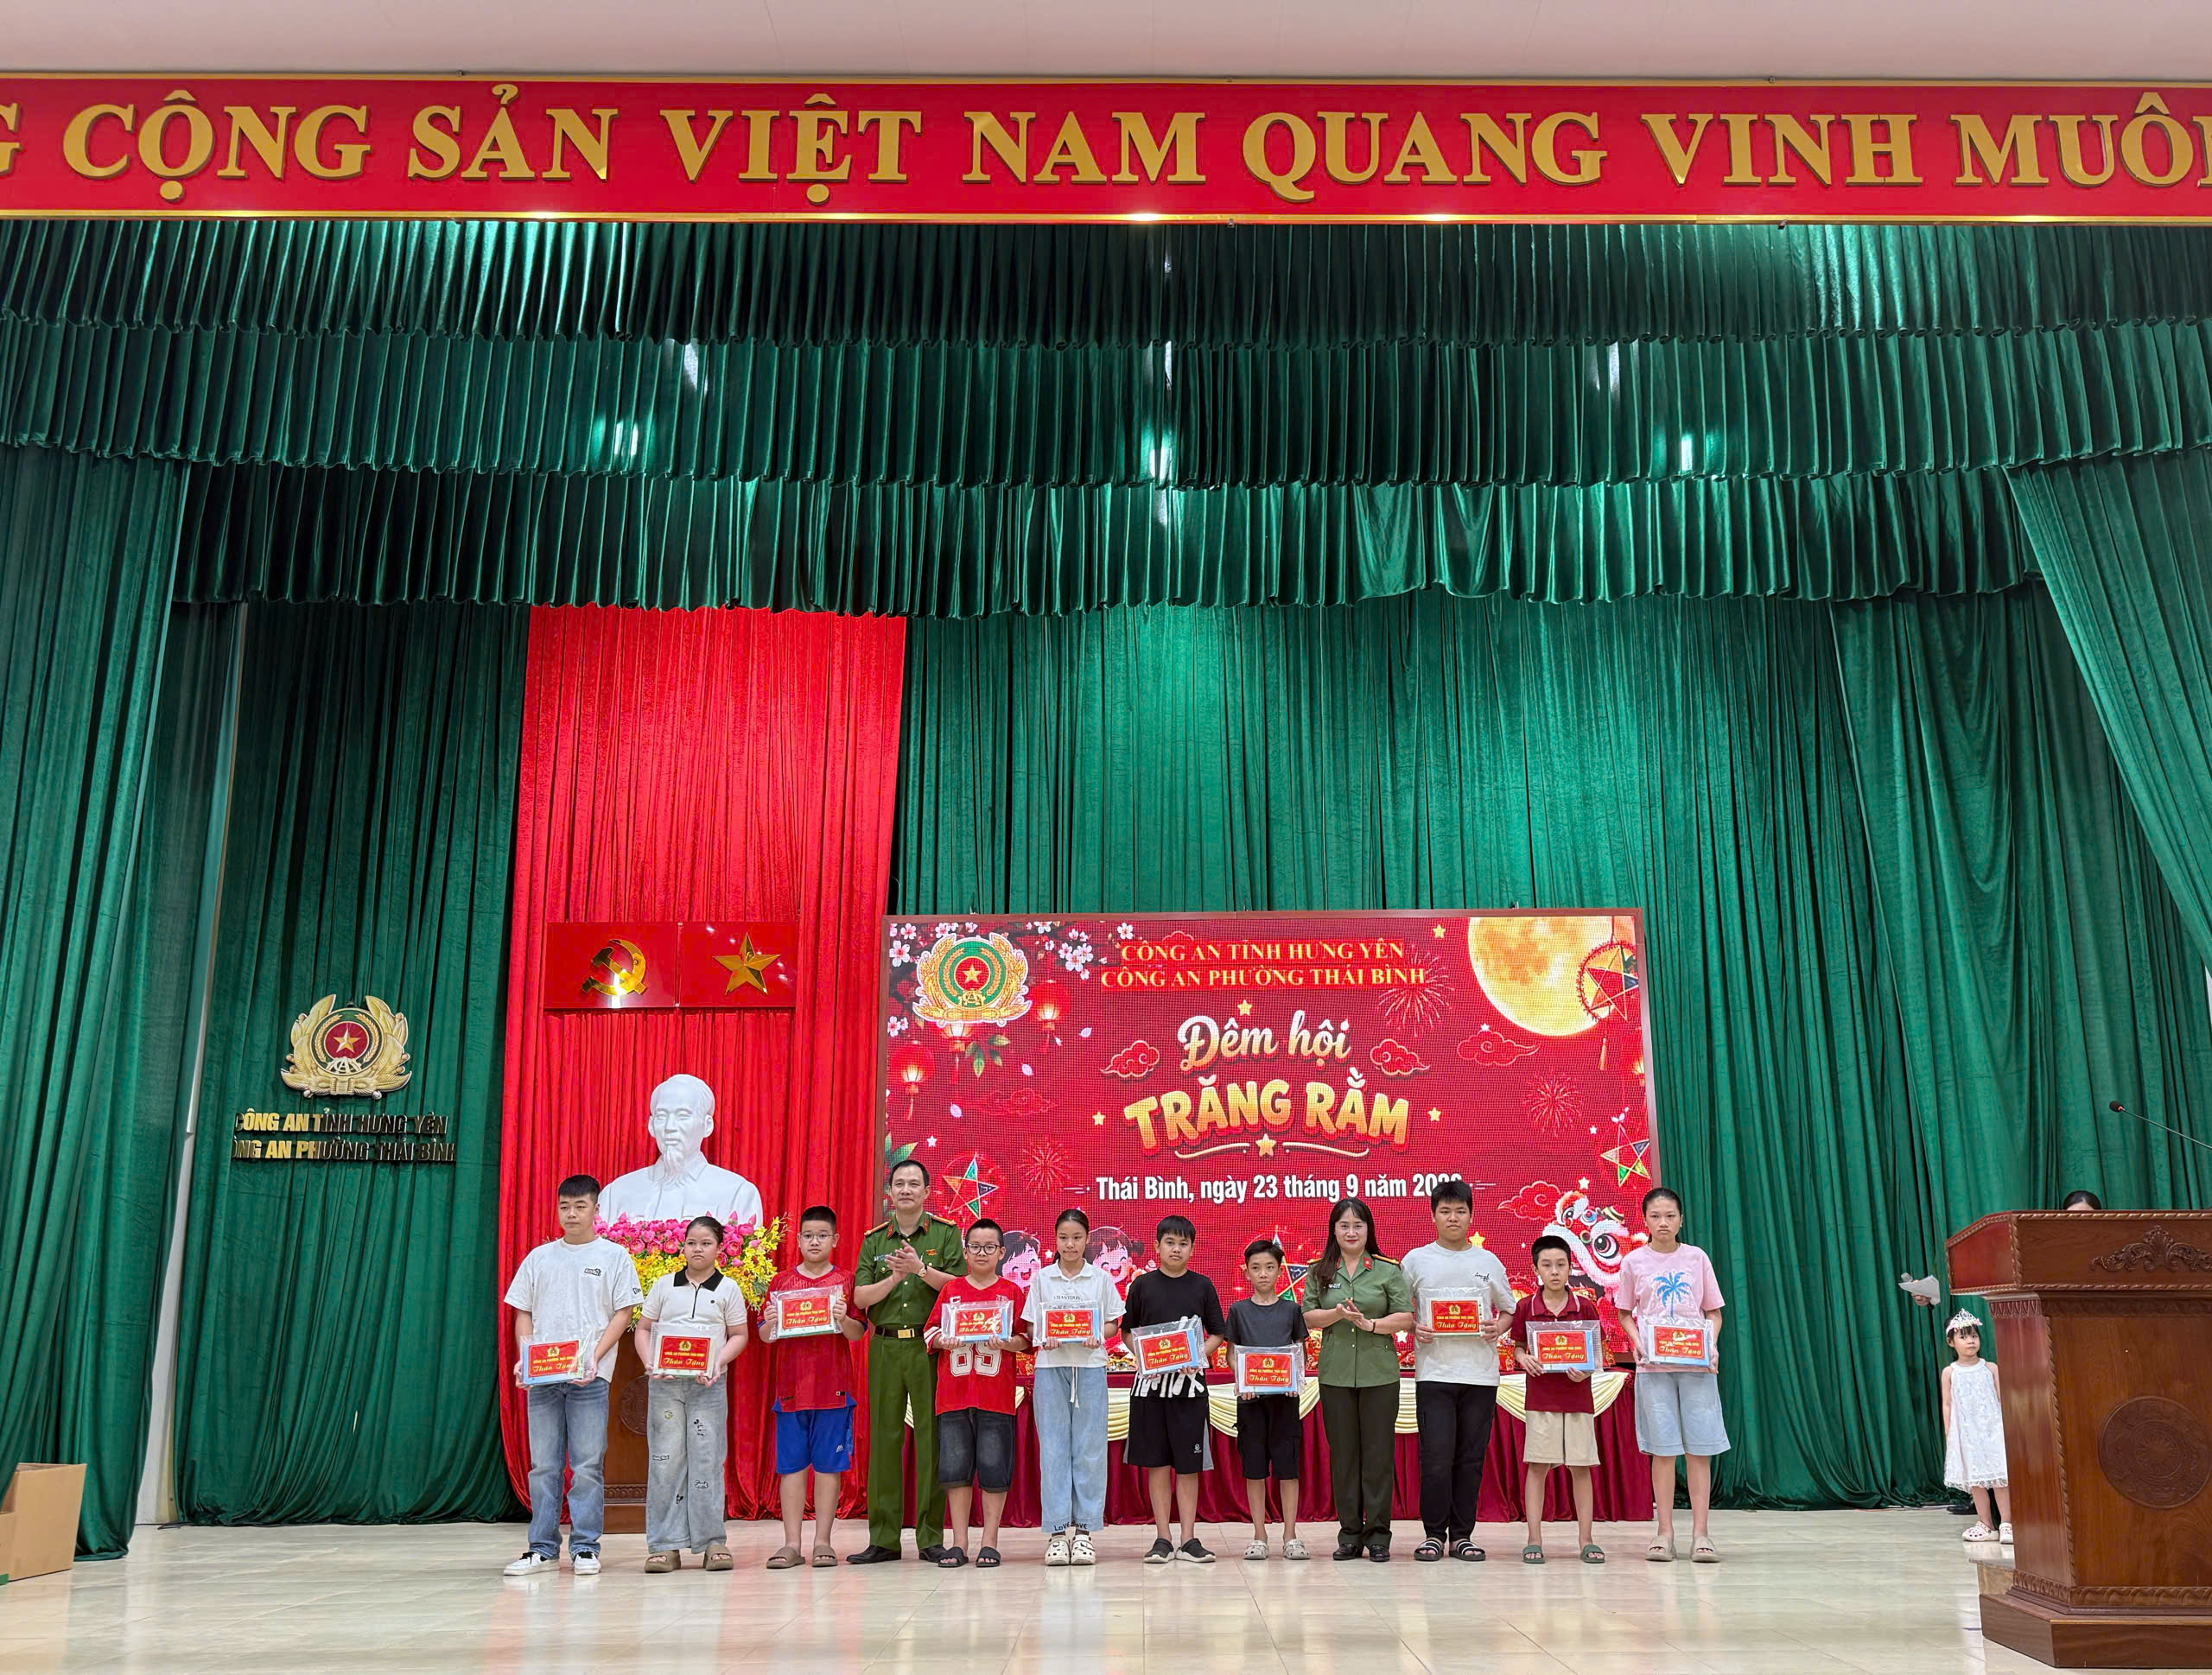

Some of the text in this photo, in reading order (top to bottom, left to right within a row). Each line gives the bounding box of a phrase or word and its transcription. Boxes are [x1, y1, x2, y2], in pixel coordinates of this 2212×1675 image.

[62, 90, 371, 200] CỘNG
[408, 84, 618, 181] SẢN
[660, 92, 921, 205] VIỆT
[963, 111, 1206, 185] NAM
[1243, 111, 1607, 203] QUANG
[1642, 113, 1923, 187] VINH
[1949, 92, 2212, 187] MUÔ
[1122, 940, 1185, 961] CÔNG
[1191, 944, 1220, 960] AN
[1288, 941, 1353, 960] HƯNG
[1359, 938, 1403, 959] YÊN
[1102, 963, 1425, 987] CÔNG AN PHƯỜNG THÁI BÌNH
[1177, 1009, 1352, 1071] Đêm hội
[234, 1107, 448, 1134] CÔNG AN TỈNH HƯNG YÊN
[1123, 1067, 1410, 1150] TRĂNG RẰM
[265, 1140, 292, 1158] AN
[296, 1136, 370, 1160] PHƯỜNG
[377, 1137, 415, 1161] THÁI
[1096, 1176, 1138, 1200] Thái
[1145, 1175, 1194, 1202] Bình,
[1200, 1175, 1248, 1204] ngày
[1253, 1174, 1278, 1198] 23
[1283, 1174, 1340, 1202] tháng
[1345, 1173, 1358, 1197] 9
[1364, 1174, 1407, 1197] năm
